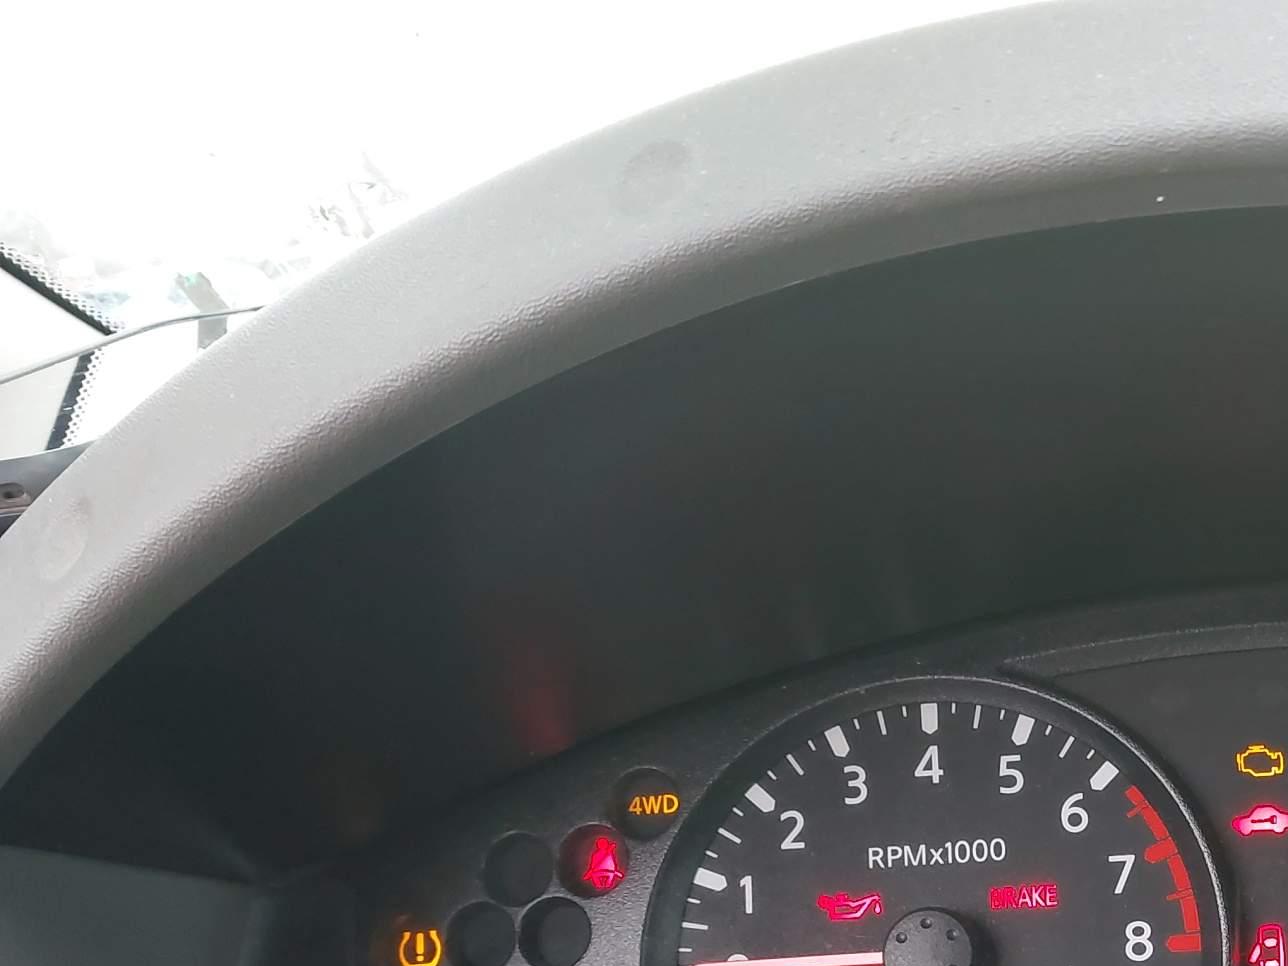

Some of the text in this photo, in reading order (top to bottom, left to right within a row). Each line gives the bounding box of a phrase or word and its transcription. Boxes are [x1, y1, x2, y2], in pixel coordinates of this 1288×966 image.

[914, 745, 944, 784] 4
[999, 754, 1024, 794] 5
[628, 792, 681, 817] 4WD
[843, 765, 868, 805] 3
[780, 810, 806, 850] 2
[1060, 792, 1090, 834] 6
[868, 838, 1006, 869] RPMx1000
[1108, 854, 1136, 894] 7
[739, 875, 753, 914] 1
[990, 883, 1058, 909] BRAKE
[1125, 920, 1154, 962] 8
